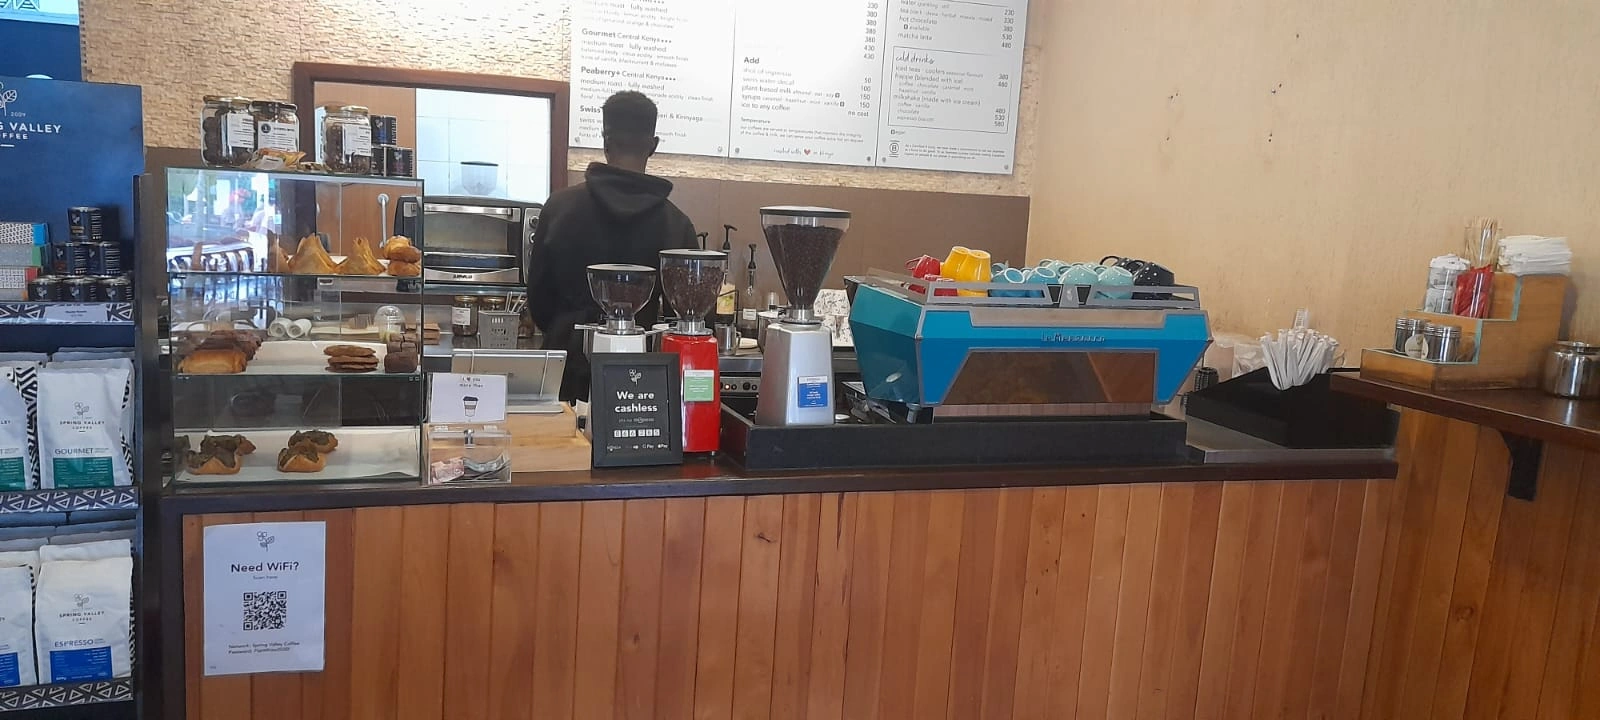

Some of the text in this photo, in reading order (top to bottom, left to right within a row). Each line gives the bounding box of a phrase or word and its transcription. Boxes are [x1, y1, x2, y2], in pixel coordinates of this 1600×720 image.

[630, 3, 643, 11] fully
[910, 17, 938, 25] chocolate
[582, 28, 660, 43] Gourmet Central Kenya
[608, 41, 624, 49] roast
[629, 43, 642, 51] fully
[643, 45, 667, 53] washed
[896, 51, 935, 65] cold drinks
[622, 71, 645, 79] Central
[646, 73, 665, 81] Kenya
[915, 75, 939, 83] (blended
[628, 81, 641, 89] fully
[642, 83, 665, 91] washed
[759, 85, 778, 93] based
[779, 86, 792, 94] milk
[922, 95, 939, 103] (made
[580, 105, 601, 113] Swiss
[741, 116, 771, 124] Temperature
[9, 122, 61, 134] VALLEY
[617, 391, 654, 400] We are
[614, 403, 658, 413] cashless
[231, 561, 299, 573] Need WiFi?
[54, 639, 94, 647] ESPRESSO
